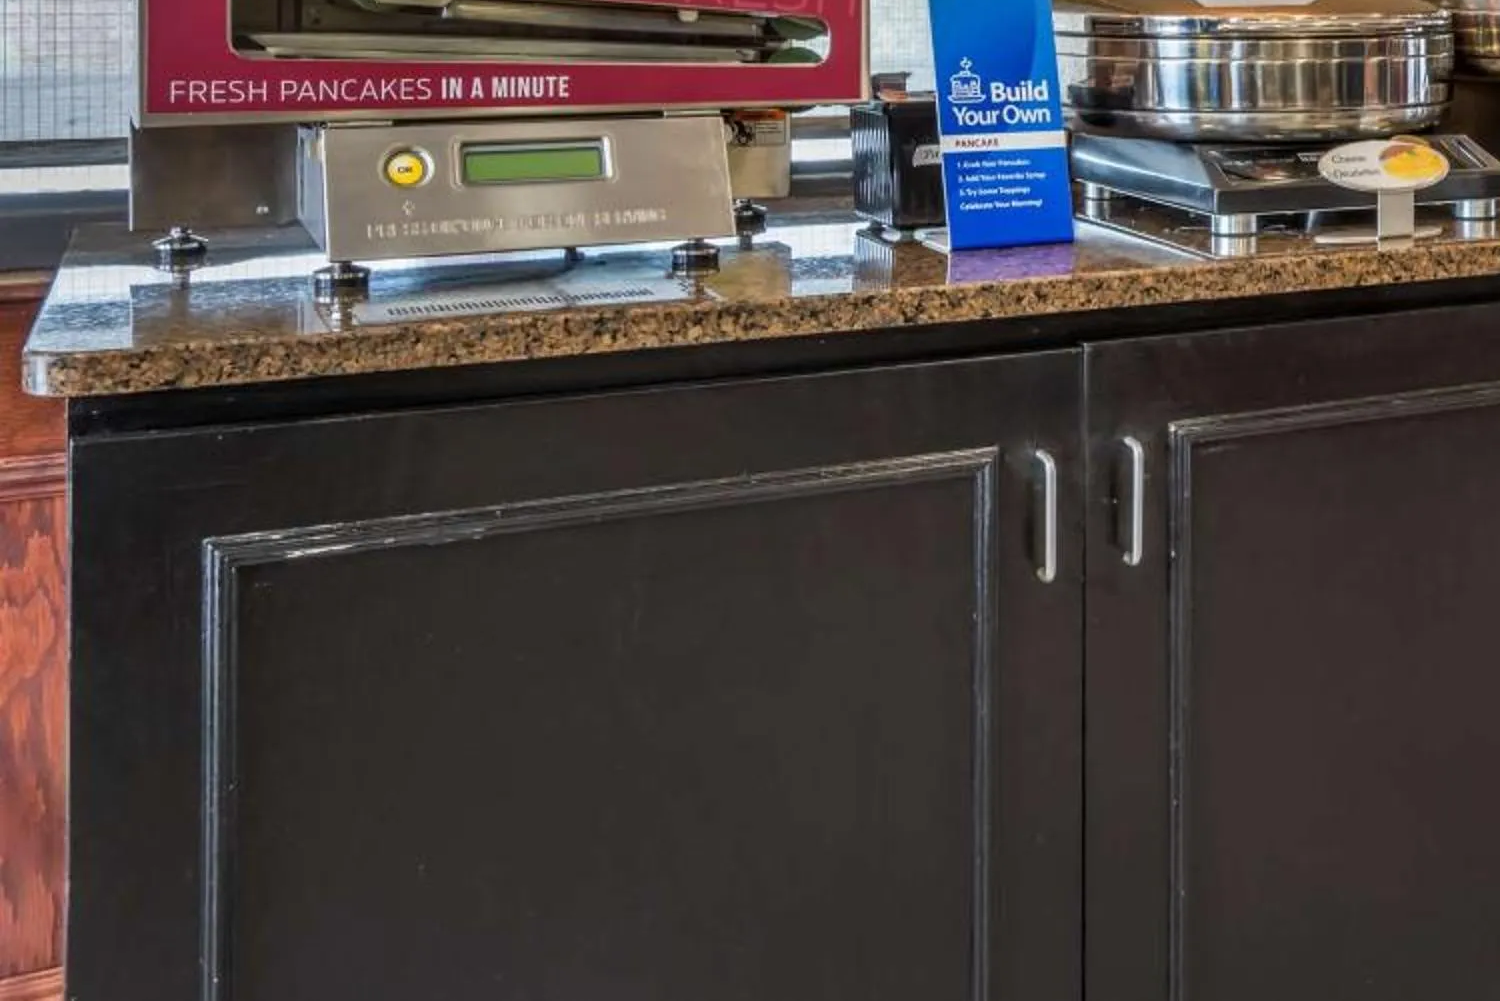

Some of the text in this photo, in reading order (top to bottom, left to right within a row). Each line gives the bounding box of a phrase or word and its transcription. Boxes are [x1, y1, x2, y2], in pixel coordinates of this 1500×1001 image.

[170, 74, 569, 104] FRESH PANCAKES IN A MINUTE
[990, 80, 1049, 103] Build
[952, 104, 1052, 126] Your Own
[955, 138, 999, 148] PANCAKE
